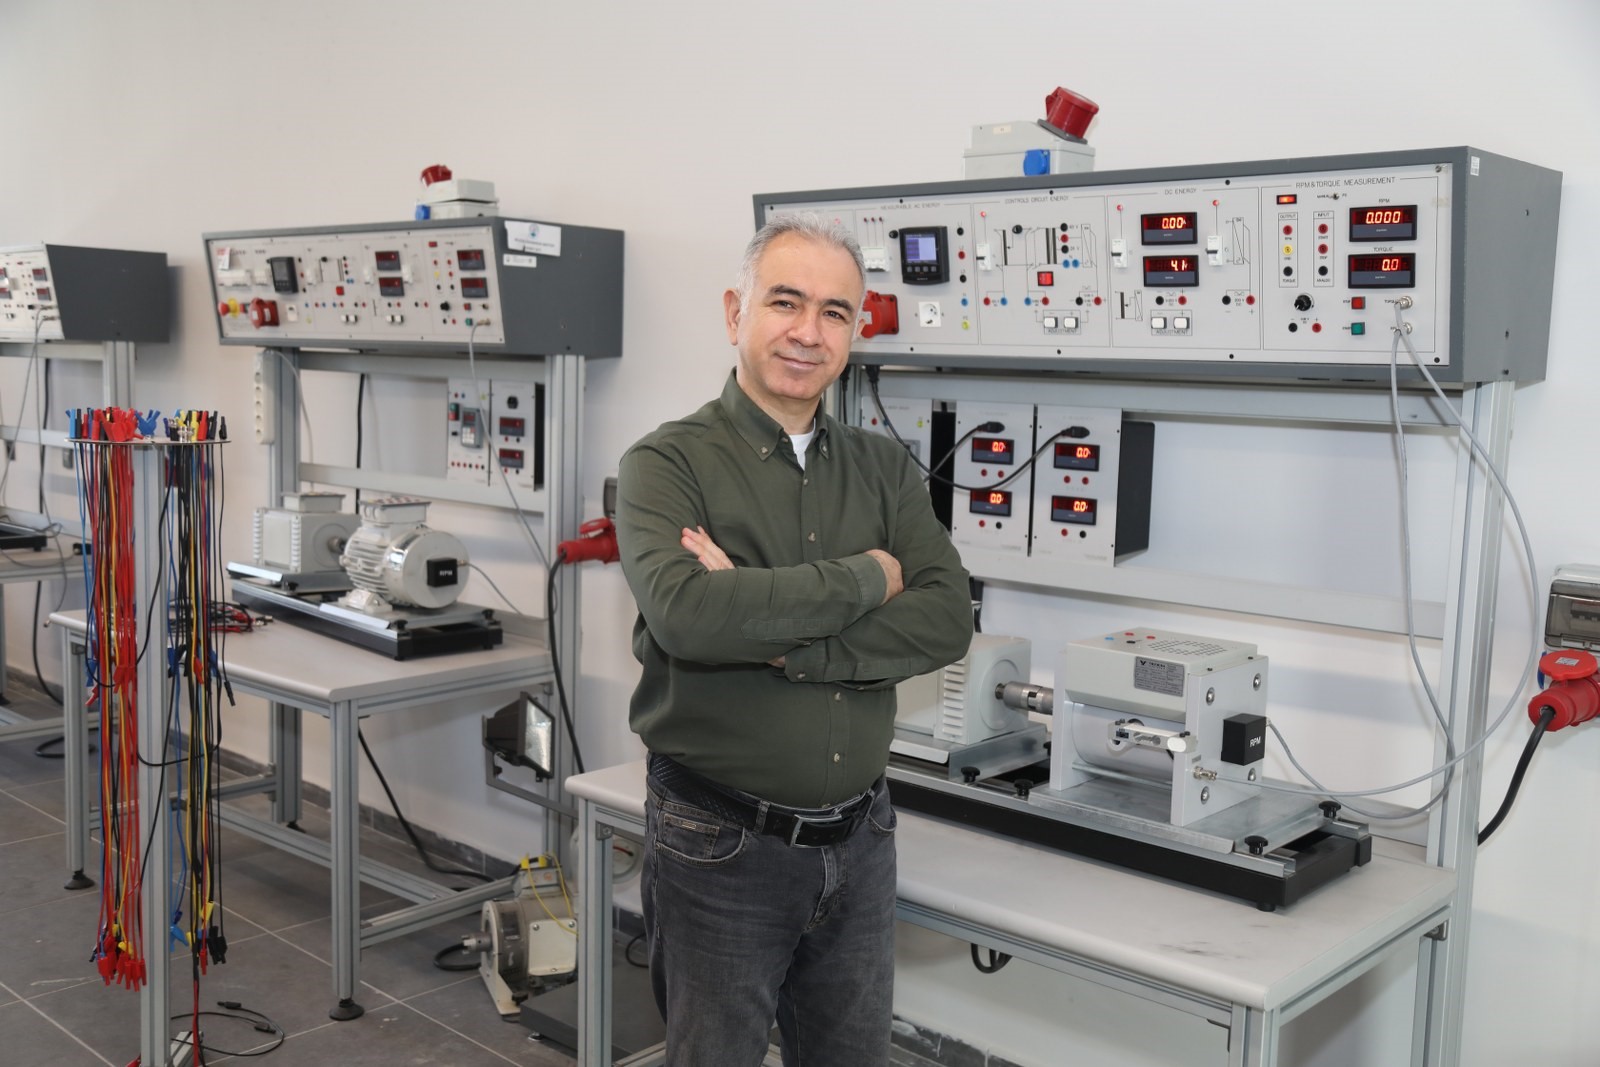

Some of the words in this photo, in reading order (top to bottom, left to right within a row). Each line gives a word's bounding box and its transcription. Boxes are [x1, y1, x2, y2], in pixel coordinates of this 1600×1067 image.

[1343, 177, 1396, 186] MEASUREMENT
[1174, 187, 1197, 195] ENERGY
[1249, 736, 1261, 748] RPM
